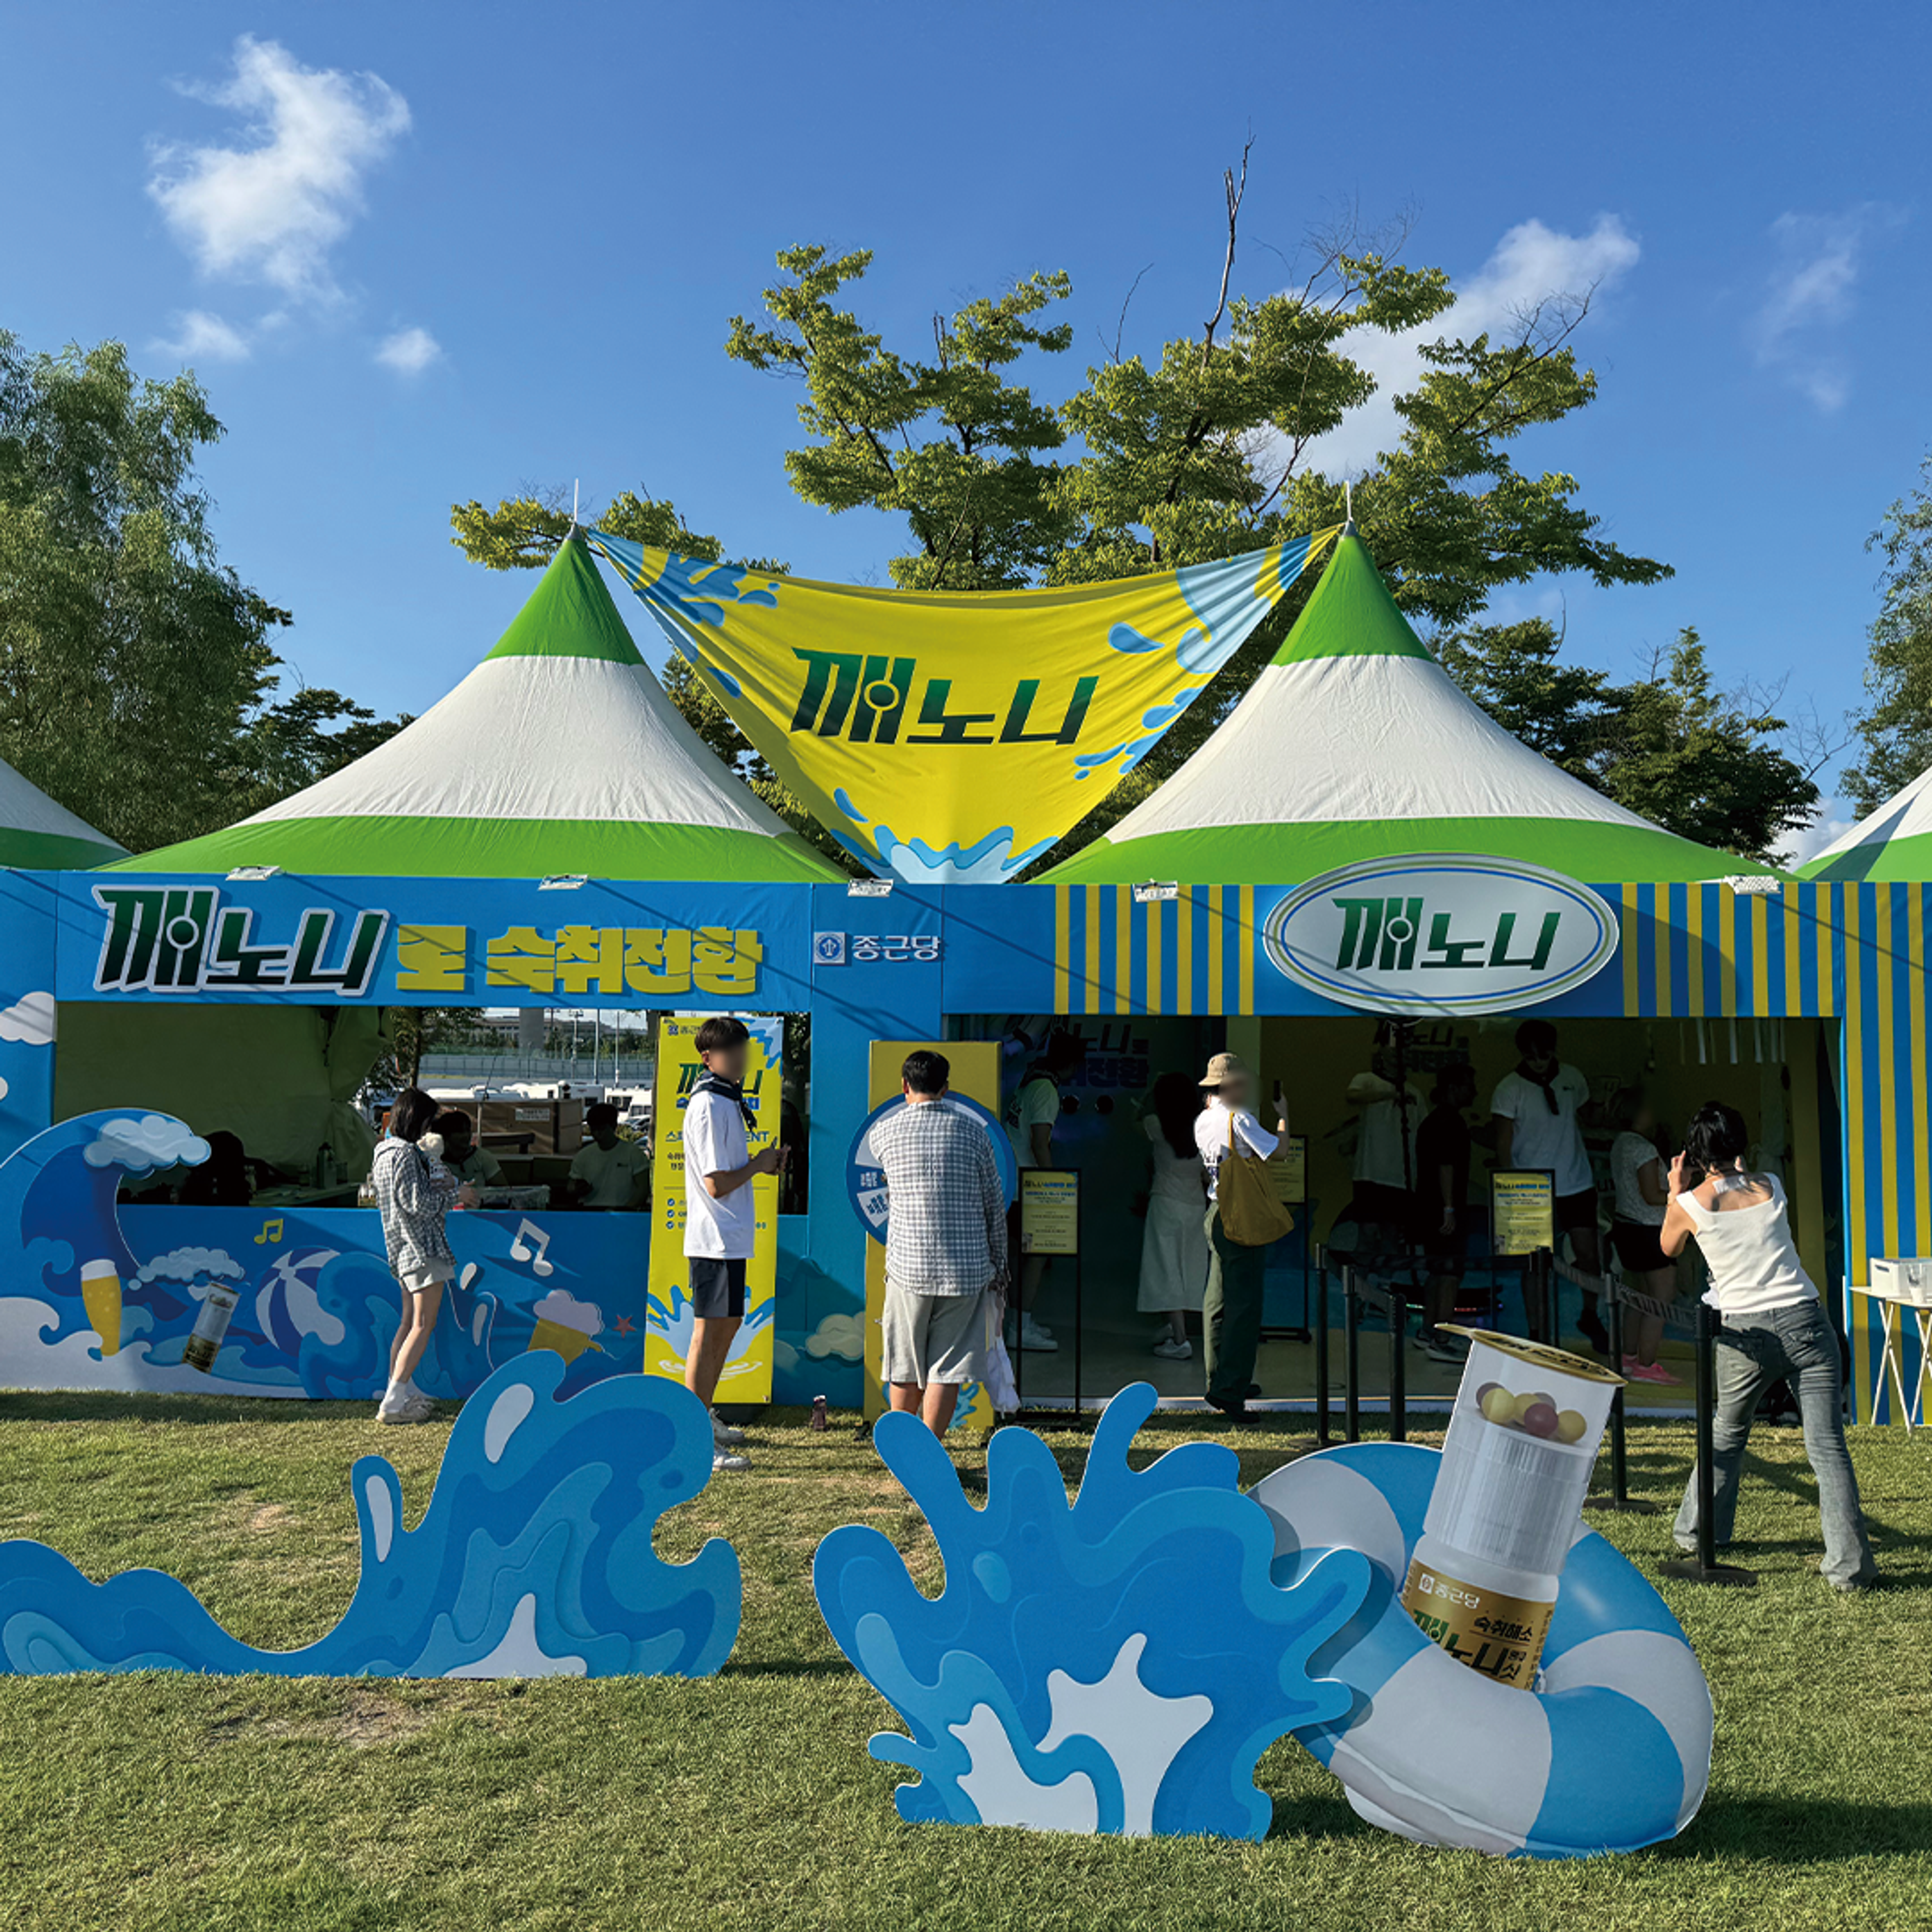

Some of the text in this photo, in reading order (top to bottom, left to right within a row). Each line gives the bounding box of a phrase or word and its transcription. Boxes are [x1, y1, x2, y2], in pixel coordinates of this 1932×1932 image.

[790, 646, 1099, 745] 깨노니
[93, 886, 389, 996] 깨노니
[486, 925, 763, 995] 숙취전환
[852, 935, 940, 960] 종근당
[1331, 898, 1561, 971] 깨노니
[1435, 1581, 1480, 1609] 종근당
[1474, 1617, 1533, 1642] 숙취해소
